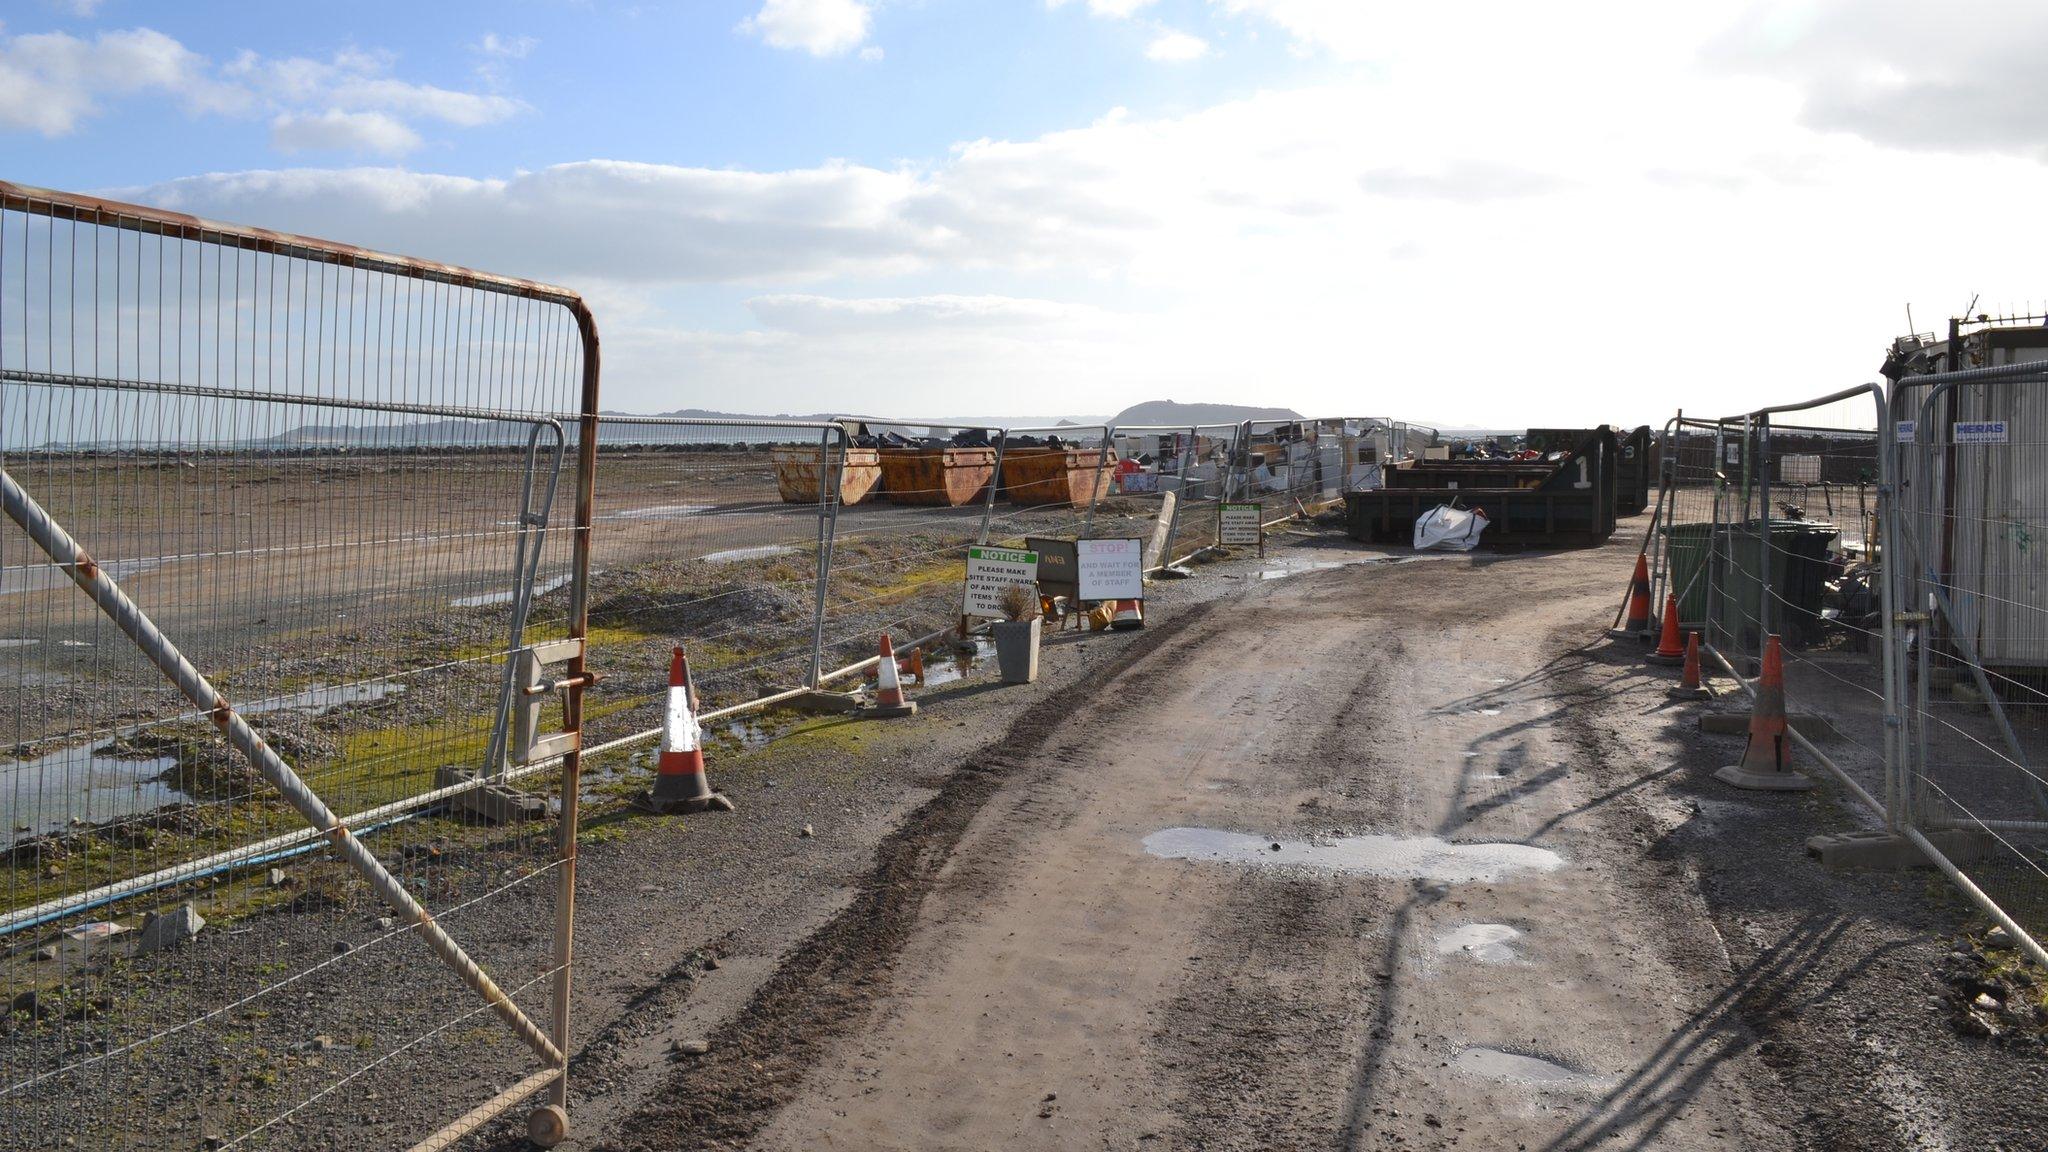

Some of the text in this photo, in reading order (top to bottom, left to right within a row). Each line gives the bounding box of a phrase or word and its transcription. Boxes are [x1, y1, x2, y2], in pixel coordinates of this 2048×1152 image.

[1956, 424, 2003, 433] HERAS
[1624, 446, 1634, 458] 3
[1574, 455, 1592, 489] 1
[1090, 543, 1128, 552] STOP!
[980, 550, 1026, 563] NOTICE
[978, 566, 1026, 576] PLEASE MAKE
